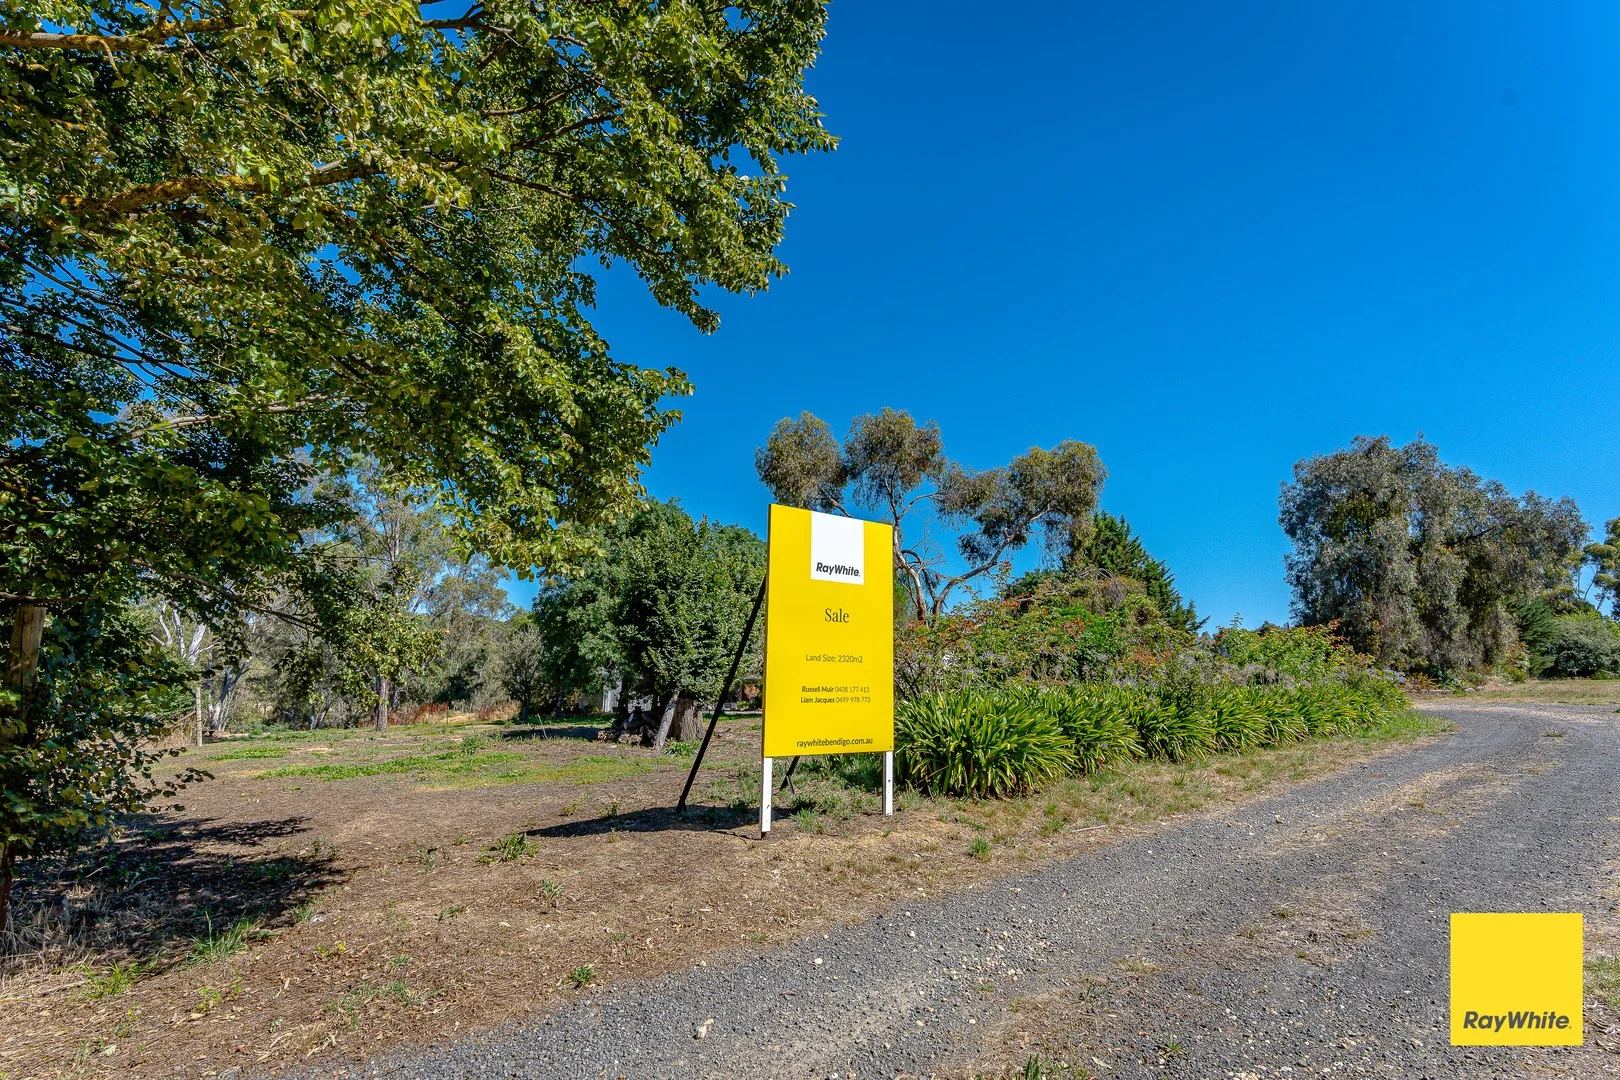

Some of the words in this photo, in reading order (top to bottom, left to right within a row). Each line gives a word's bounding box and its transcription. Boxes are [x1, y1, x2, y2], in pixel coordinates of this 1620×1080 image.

[824, 608, 850, 623] Sale
[806, 654, 821, 662] Land
[822, 654, 836, 663] Size:
[838, 655, 863, 663] 2320m2
[796, 738, 873, 748] raywhitebendigo.com.au
